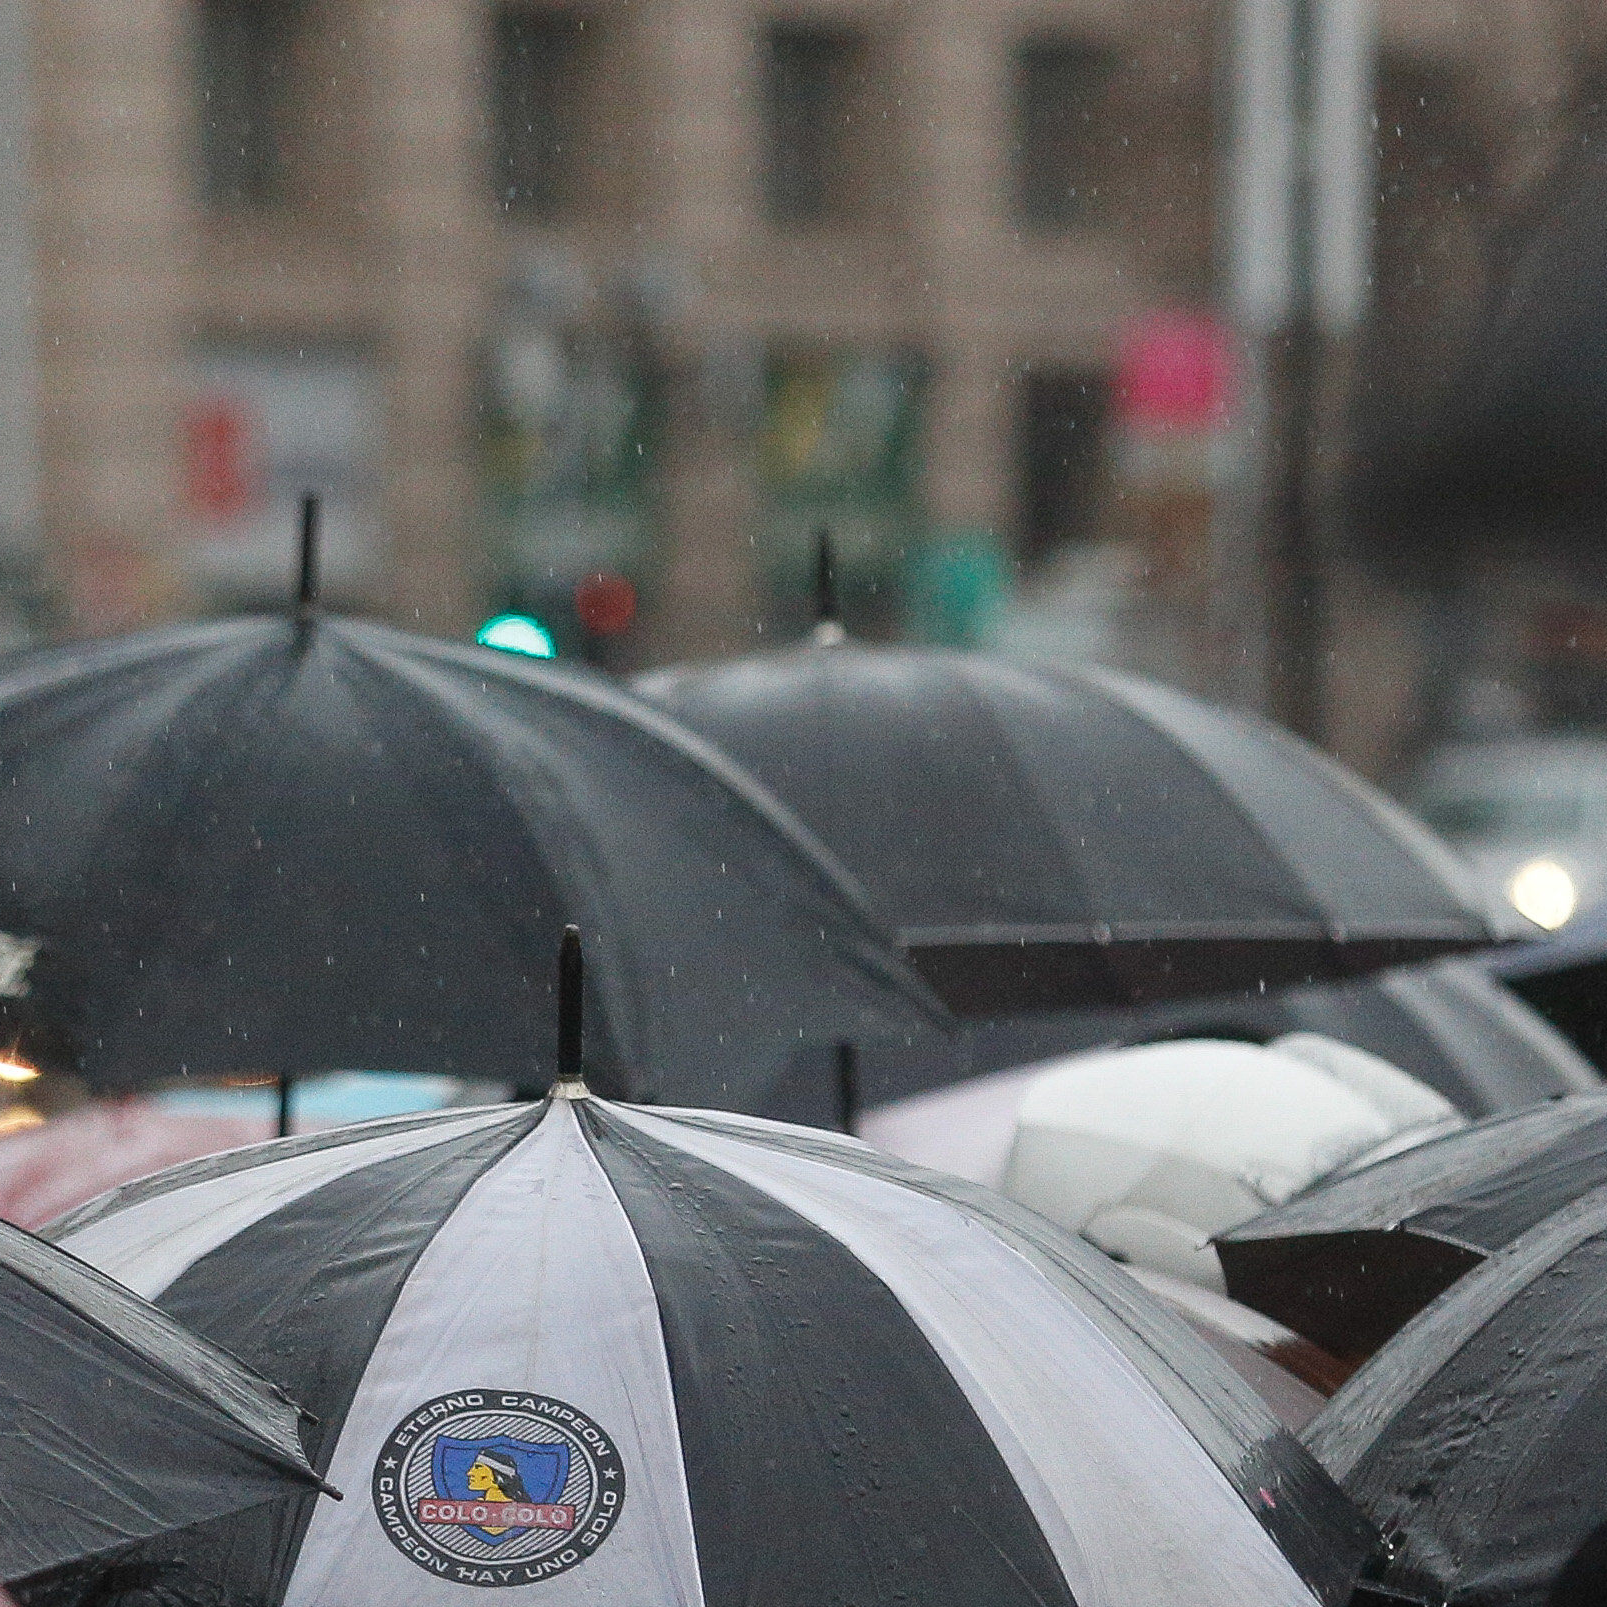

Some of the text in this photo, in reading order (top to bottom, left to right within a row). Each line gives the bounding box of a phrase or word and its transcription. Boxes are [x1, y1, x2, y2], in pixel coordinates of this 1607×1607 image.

[395, 1395, 611, 1456] ETERNO CAMPEON
[379, 1478, 617, 1584] CAMPEON HAY UNO SOLO
